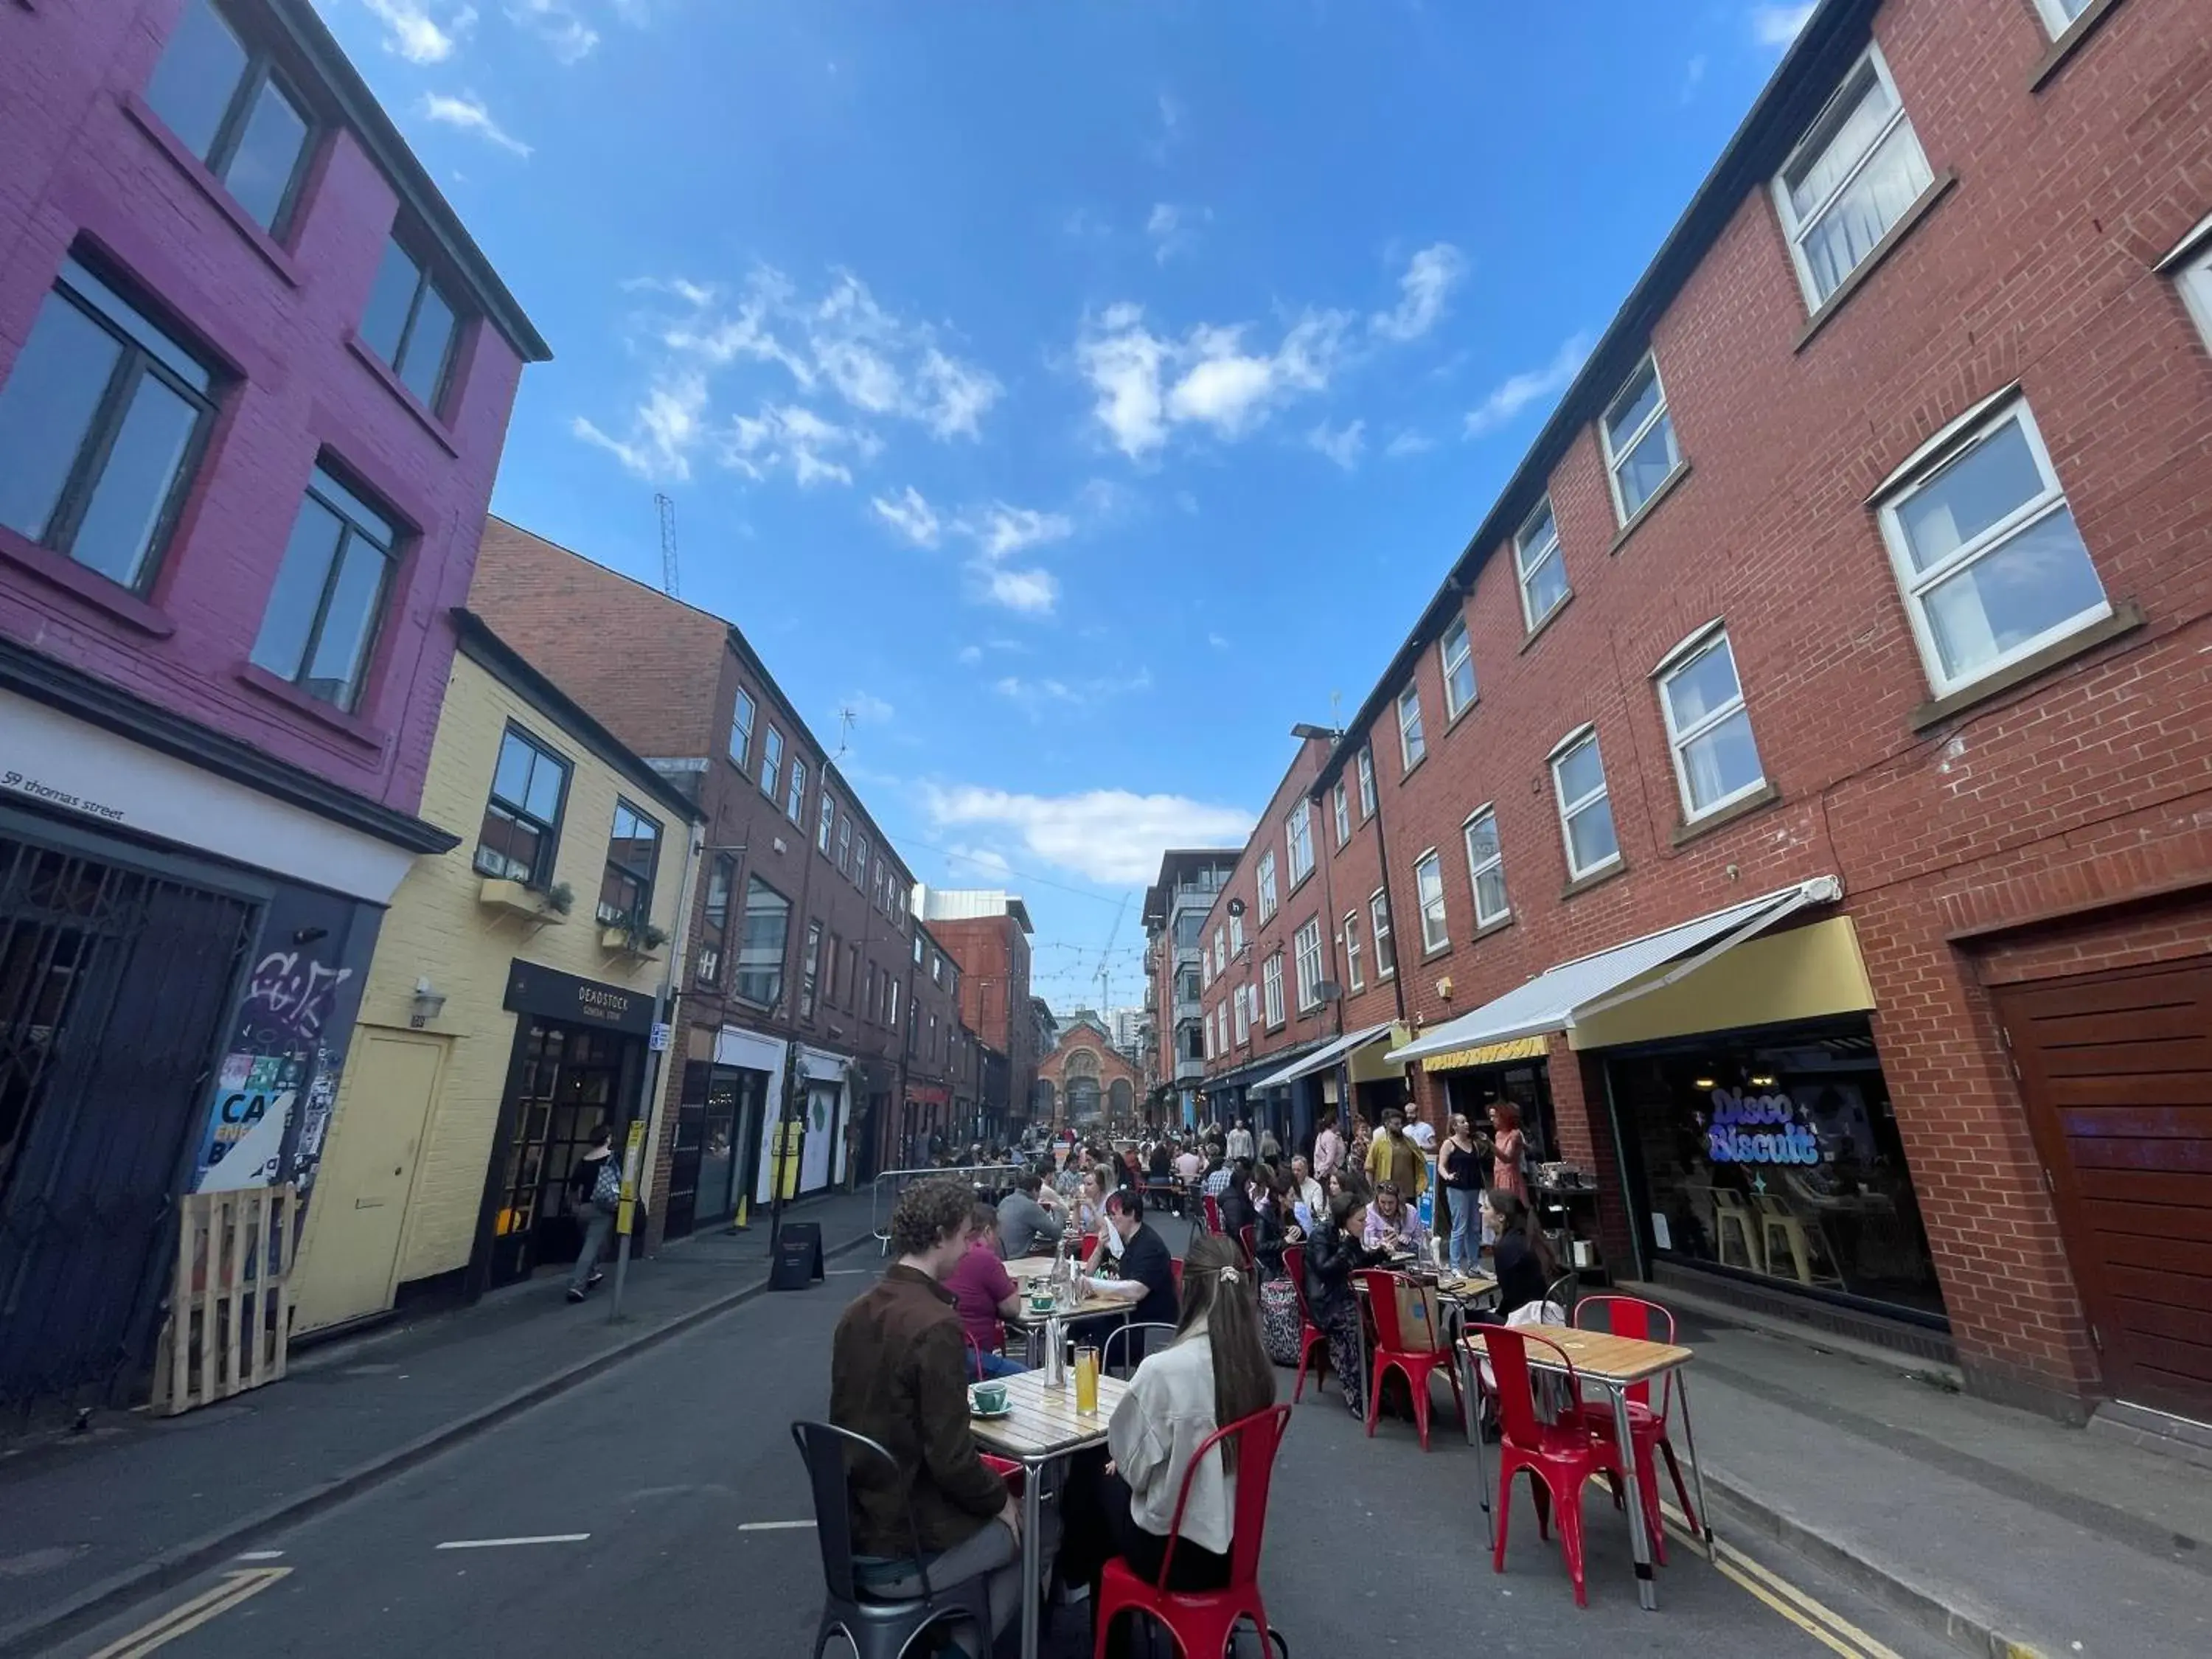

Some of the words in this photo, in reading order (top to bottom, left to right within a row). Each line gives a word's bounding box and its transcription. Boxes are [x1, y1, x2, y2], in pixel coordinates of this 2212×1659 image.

[1, 771, 23, 785] 59
[24, 780, 80, 806] thomas
[82, 799, 125, 820] street
[579, 986, 628, 1010] DEADSTOCK
[1711, 1086, 1793, 1124] Disco
[1708, 1122, 1819, 1164] Biscuit
